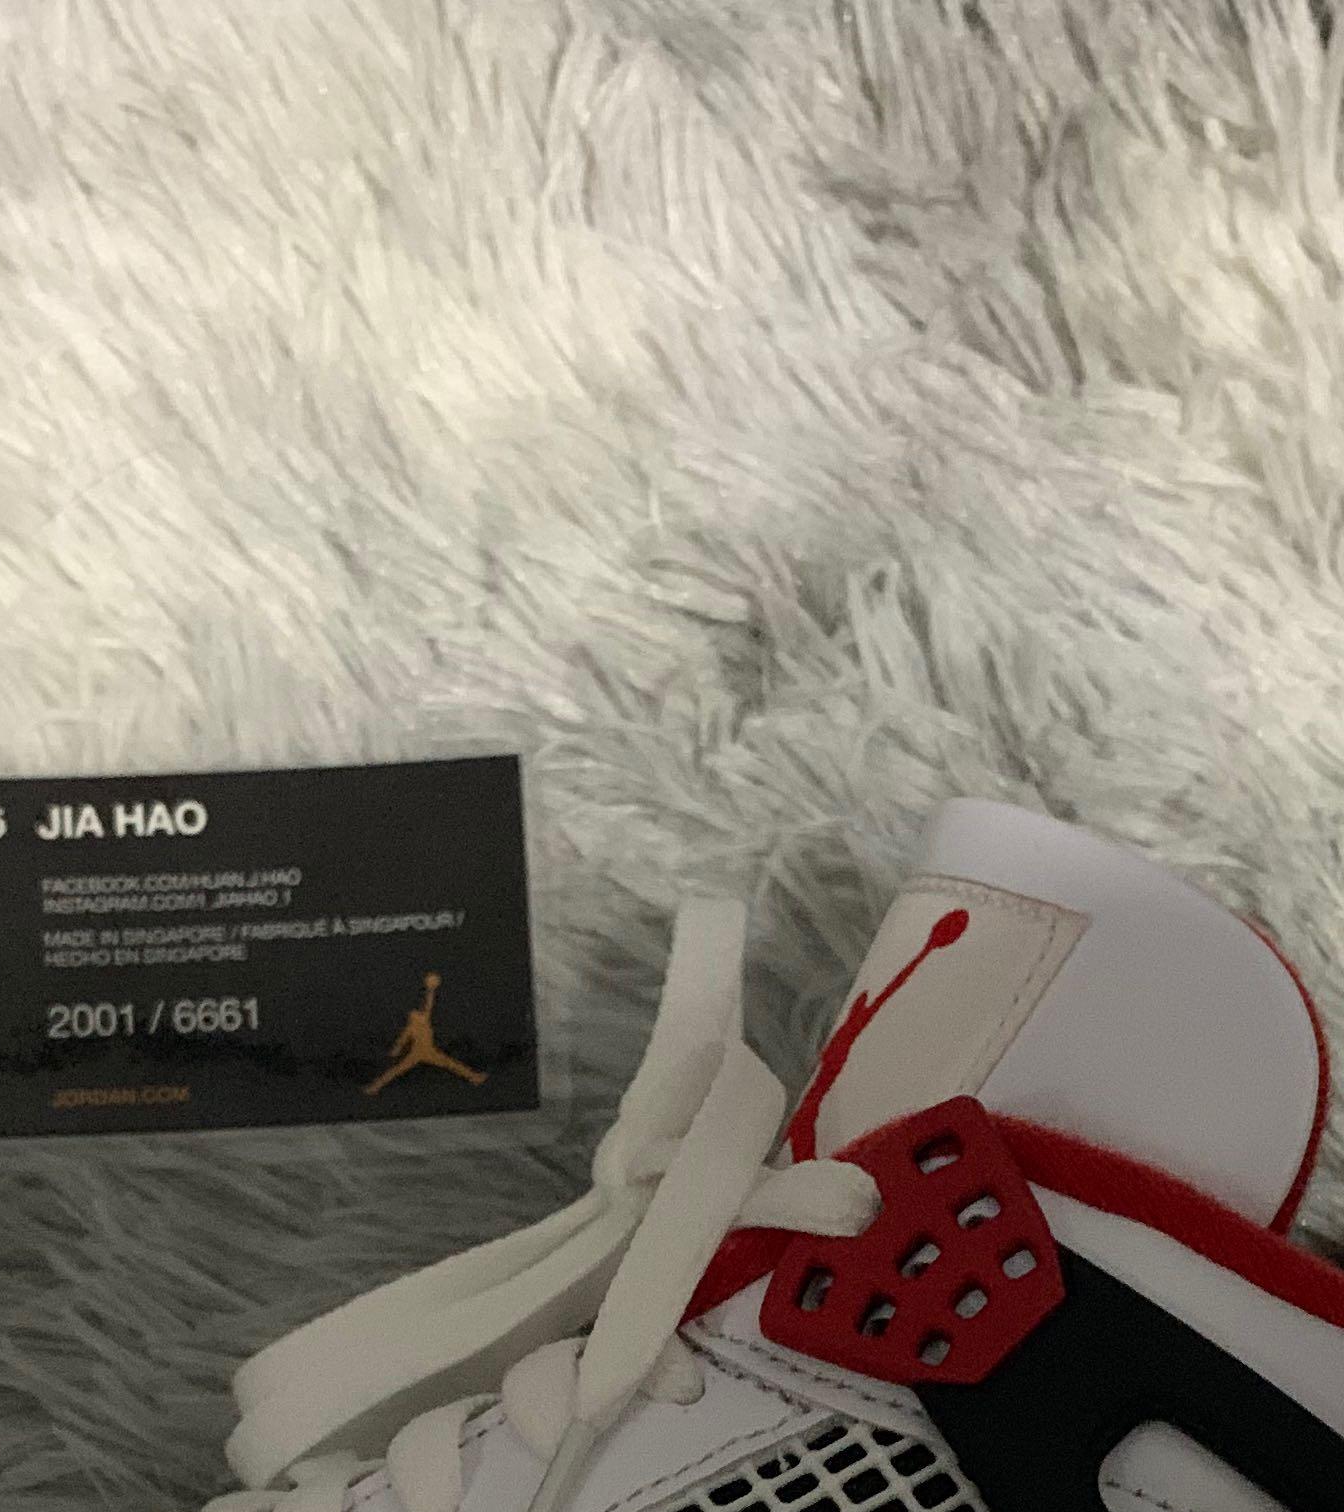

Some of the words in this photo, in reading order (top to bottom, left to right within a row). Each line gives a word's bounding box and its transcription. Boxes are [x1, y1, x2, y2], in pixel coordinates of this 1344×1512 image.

[35, 804, 103, 840] JIA
[113, 800, 208, 838] HAO
[43, 929, 91, 947] MADE
[100, 929, 119, 946] IN
[121, 925, 225, 946] SINGAPORE
[44, 949, 111, 968] HECHO
[114, 948, 140, 967] EN
[142, 943, 248, 965] SINGAPORE
[47, 1003, 134, 1040] 2001
[150, 1001, 164, 1034] /
[171, 997, 260, 1034] 6661
[55, 1085, 190, 1109] JORDAN.COM
